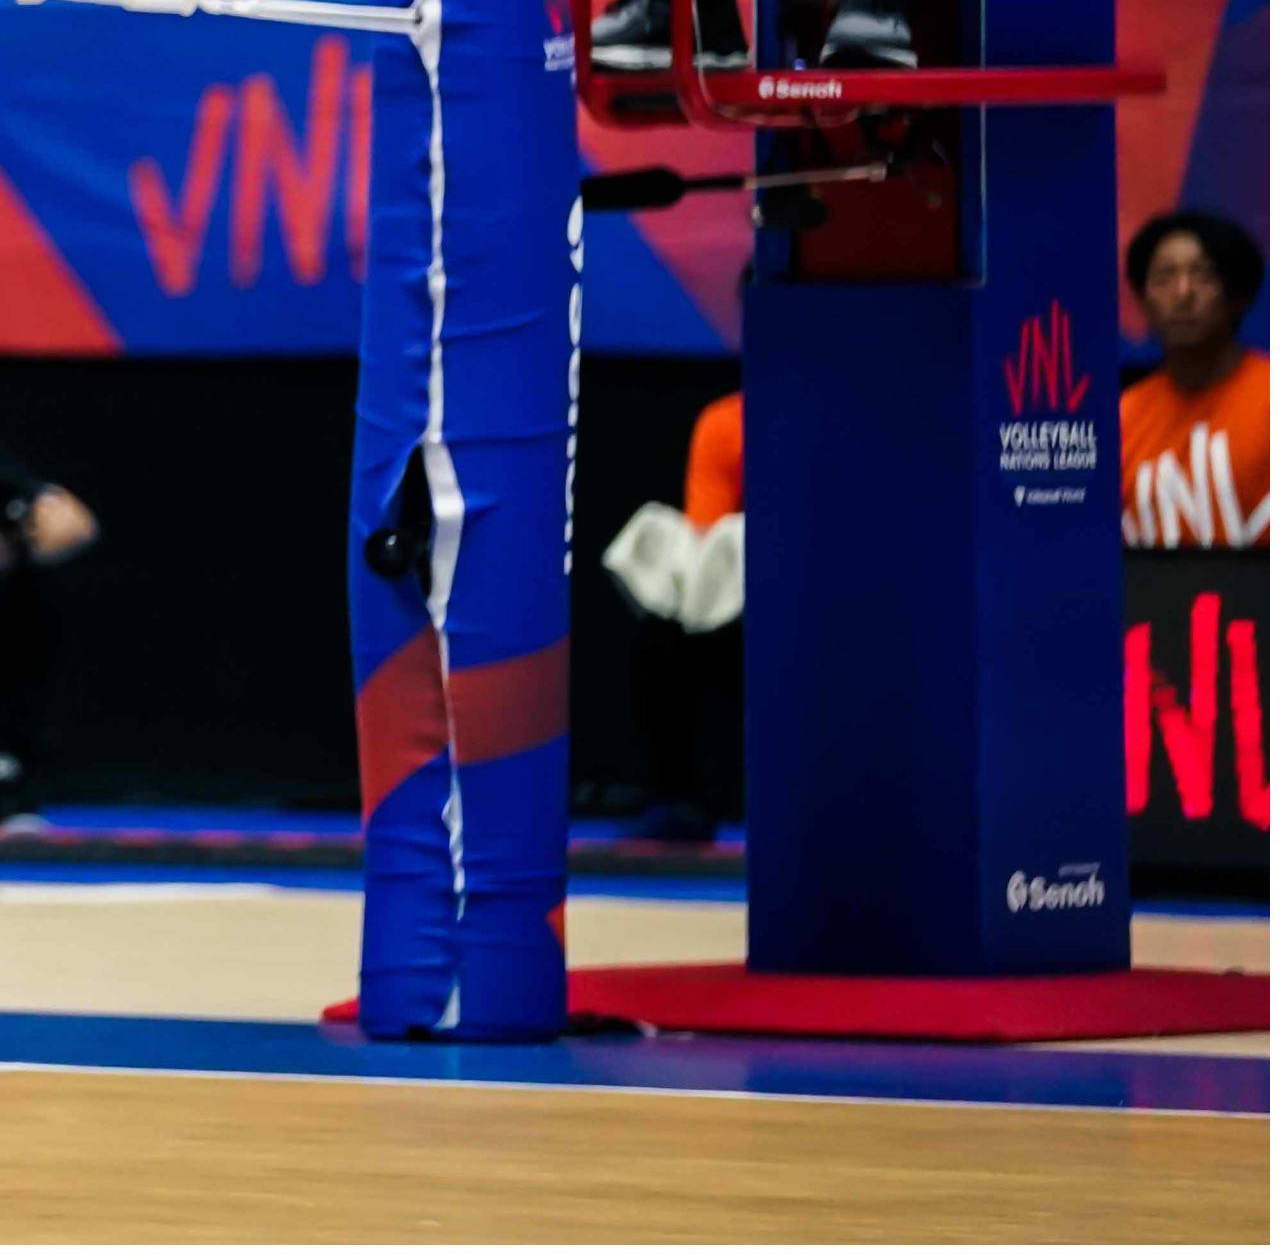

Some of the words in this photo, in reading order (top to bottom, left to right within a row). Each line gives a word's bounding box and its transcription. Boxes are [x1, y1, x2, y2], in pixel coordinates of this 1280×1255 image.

[1003, 298, 1093, 416] VNL
[999, 421, 1097, 449] VOLLEYBALL
[1123, 592, 1270, 831] NL
[1028, 875, 1105, 913] Senoh
